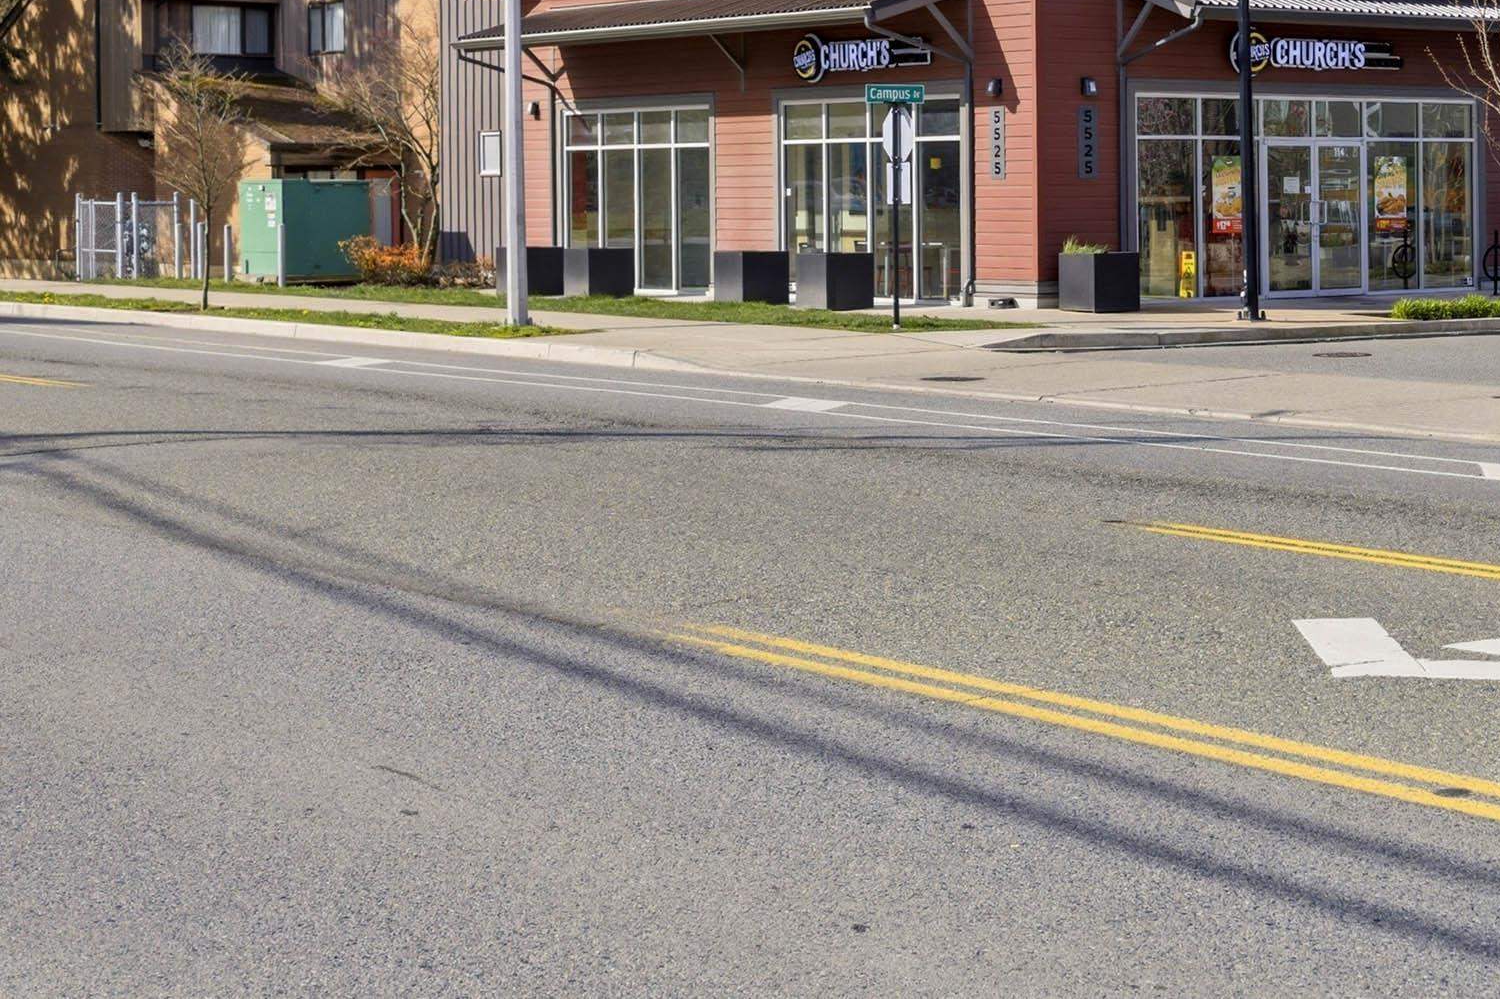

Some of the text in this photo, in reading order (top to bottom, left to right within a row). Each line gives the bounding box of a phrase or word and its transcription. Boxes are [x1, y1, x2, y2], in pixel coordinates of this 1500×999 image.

[820, 40, 890, 71] CHURCH'S
[1276, 39, 1366, 69] CHURCH'S
[870, 87, 911, 102] Campus
[993, 110, 1001, 175] 5525
[1083, 109, 1093, 174] 5525
